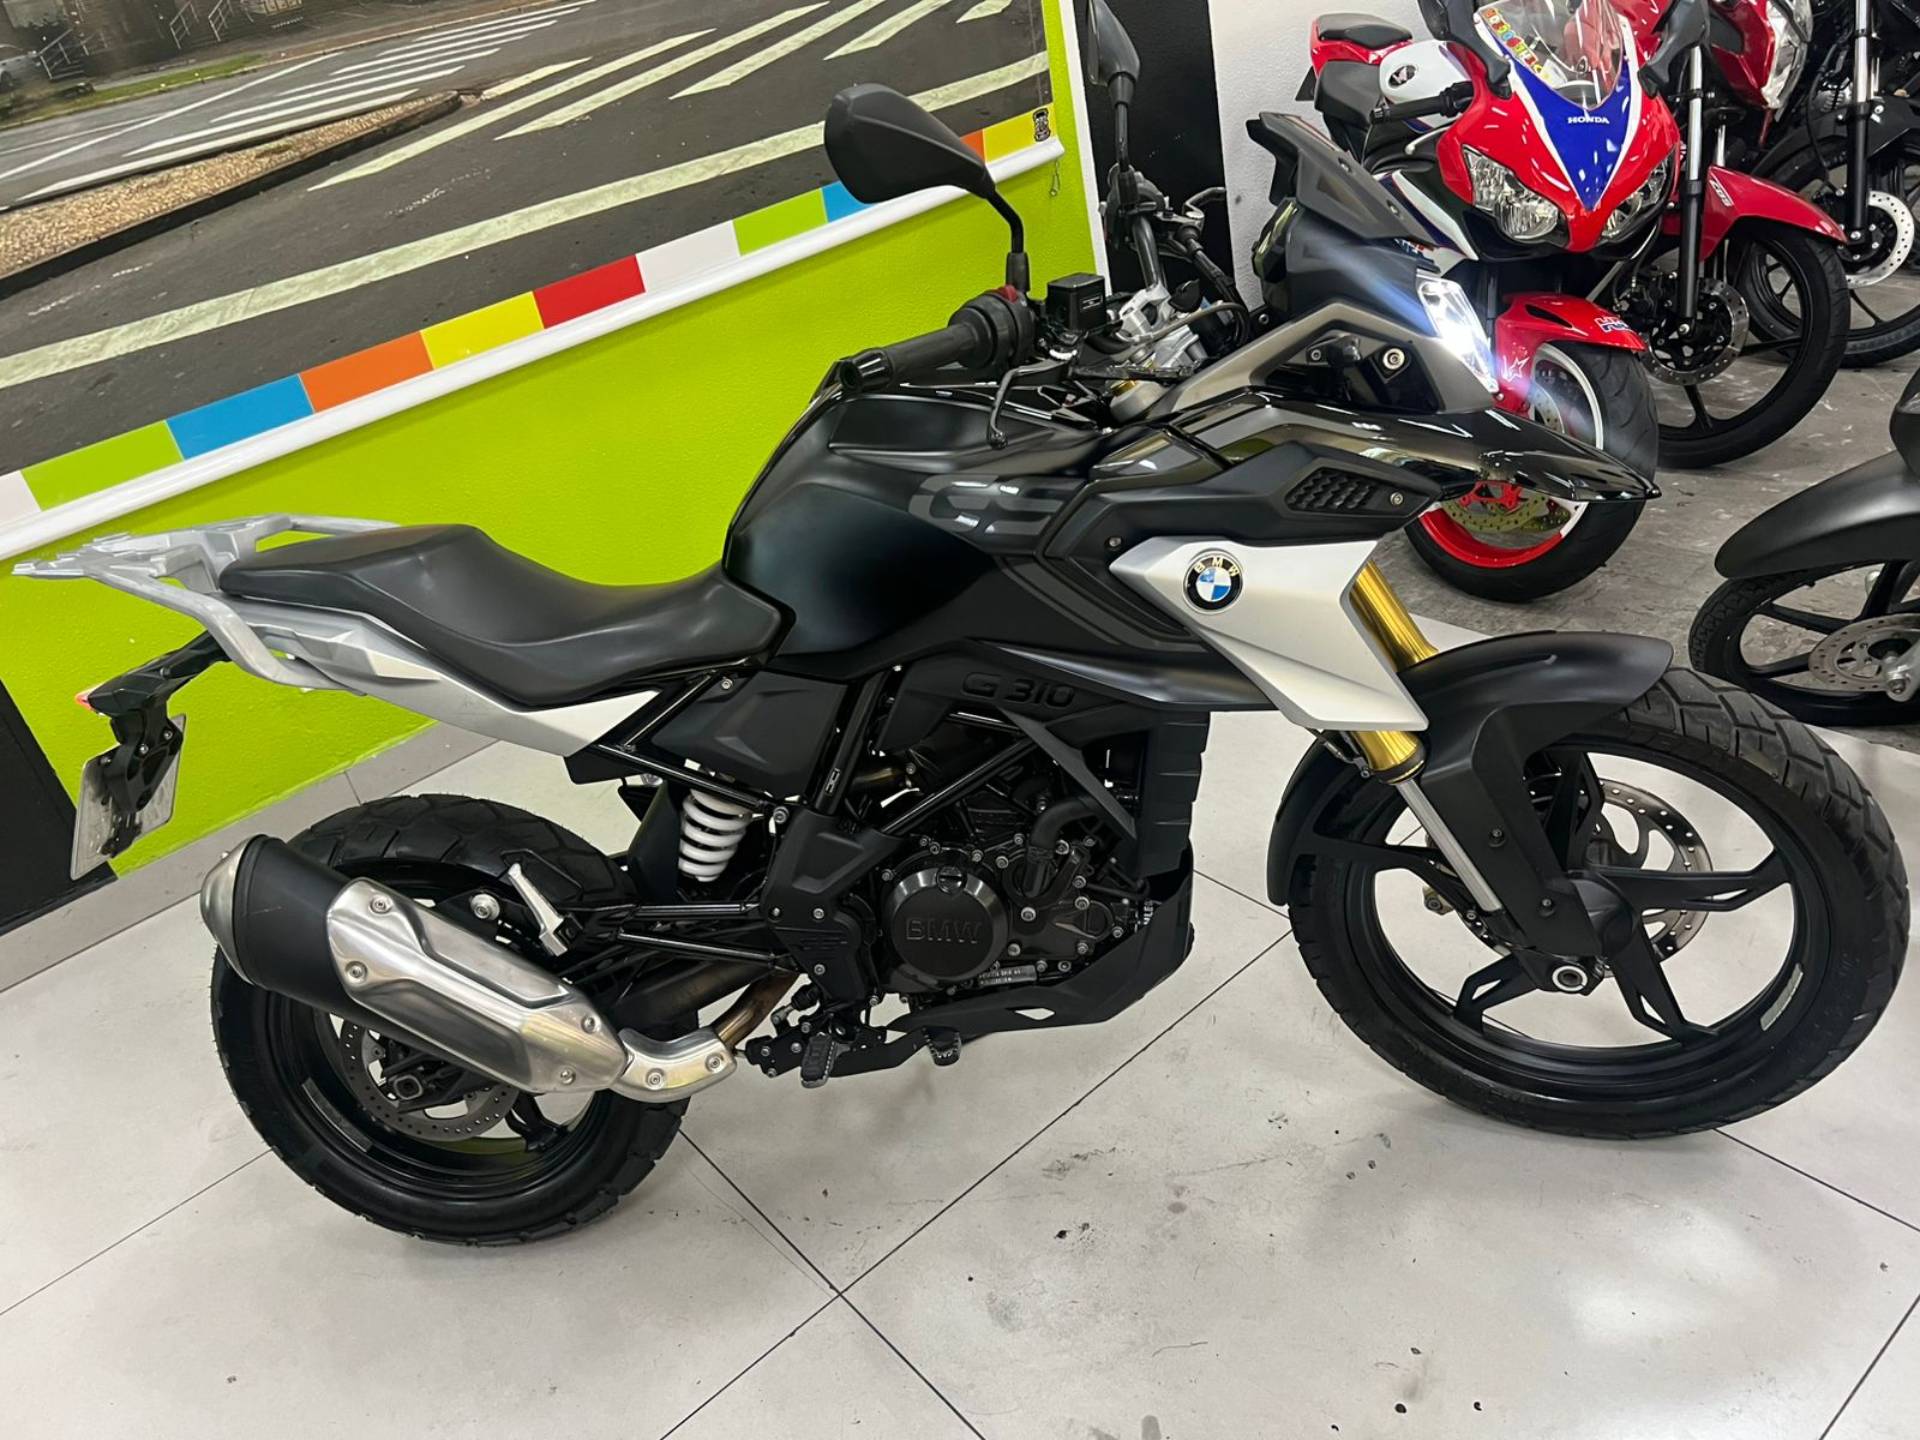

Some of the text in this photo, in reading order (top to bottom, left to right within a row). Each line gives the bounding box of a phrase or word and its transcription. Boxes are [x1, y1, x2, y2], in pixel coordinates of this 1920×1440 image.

[1567, 115, 1610, 124] HONDA
[1194, 556, 1240, 577] BMW
[961, 671, 1077, 708] G 310
[906, 917, 982, 945] BMW
